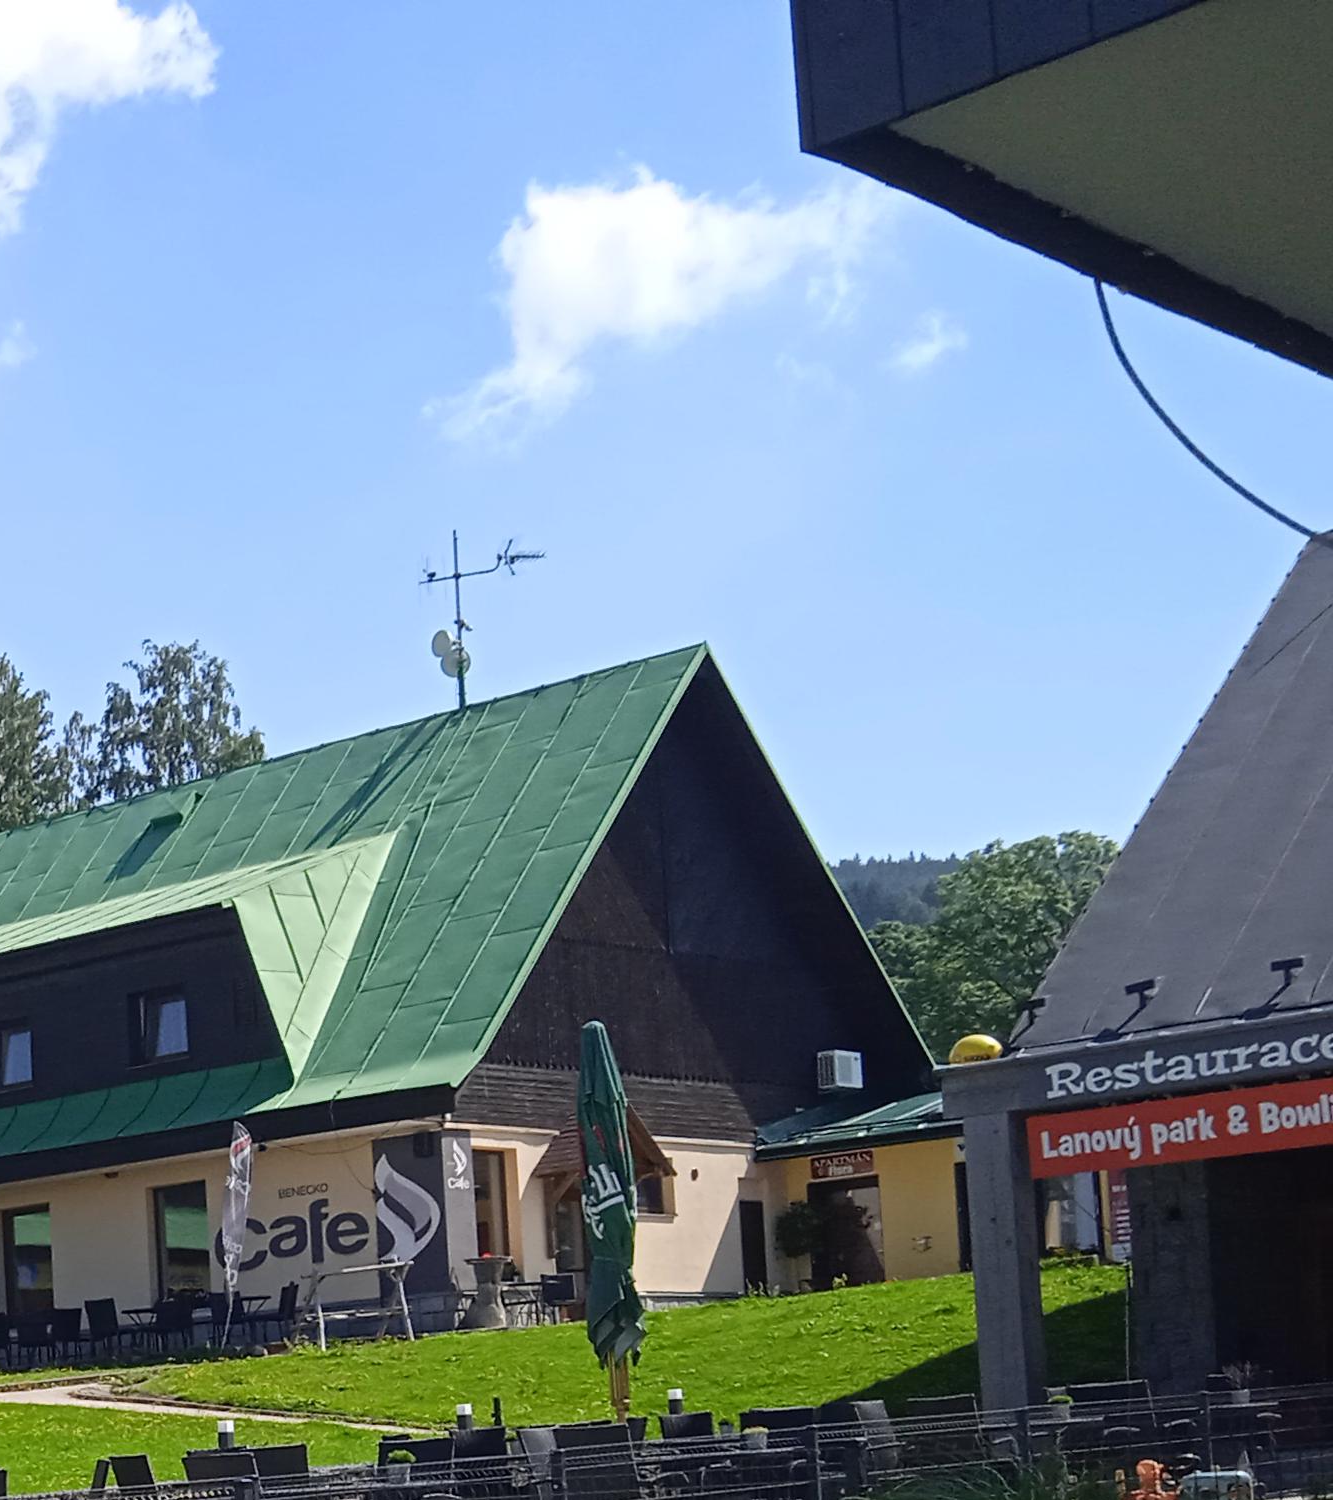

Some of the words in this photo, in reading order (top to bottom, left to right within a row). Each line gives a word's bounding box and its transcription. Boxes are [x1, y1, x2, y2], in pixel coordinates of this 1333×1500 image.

[1041, 1115, 1141, 1160] Lanový
[1151, 1108, 1217, 1155] park
[1227, 1104, 1250, 1136] &
